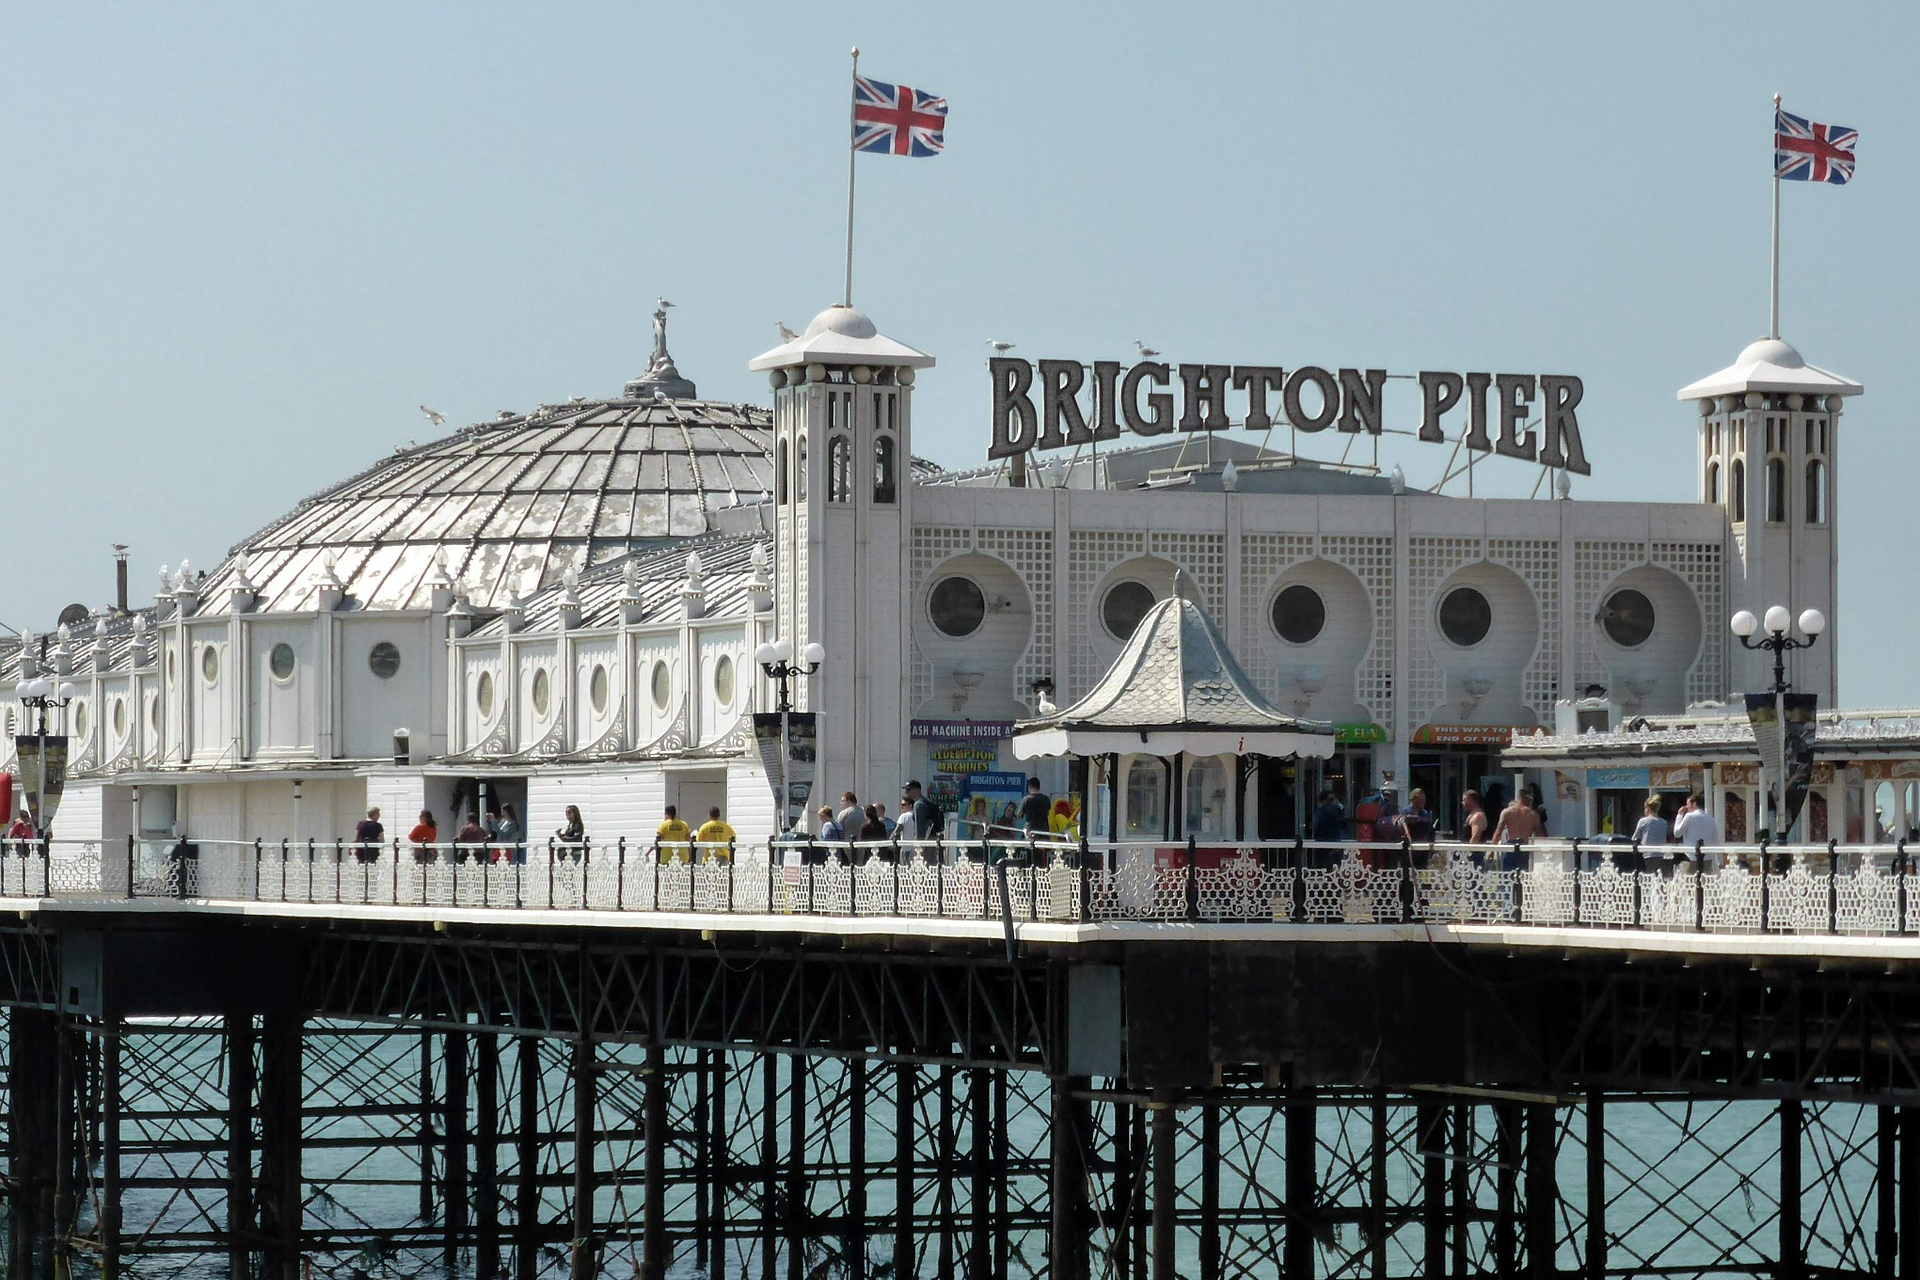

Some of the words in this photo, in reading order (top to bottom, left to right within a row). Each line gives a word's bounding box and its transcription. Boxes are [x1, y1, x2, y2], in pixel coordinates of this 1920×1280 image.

[988, 357, 1386, 461] BRIGHTON
[1417, 371, 1591, 476] PIER
[909, 725, 929, 736] ASH
[932, 725, 970, 737] MACHINE
[973, 726, 1001, 736] INSIDE
[1354, 728, 1377, 740] FUN
[930, 750, 995, 760] REDEMPTION
[937, 762, 989, 772] MACHINES
[970, 775, 1004, 785] BRIGHTON
[1006, 776, 1021, 785] PIER
[929, 793, 959, 802] WHERE
